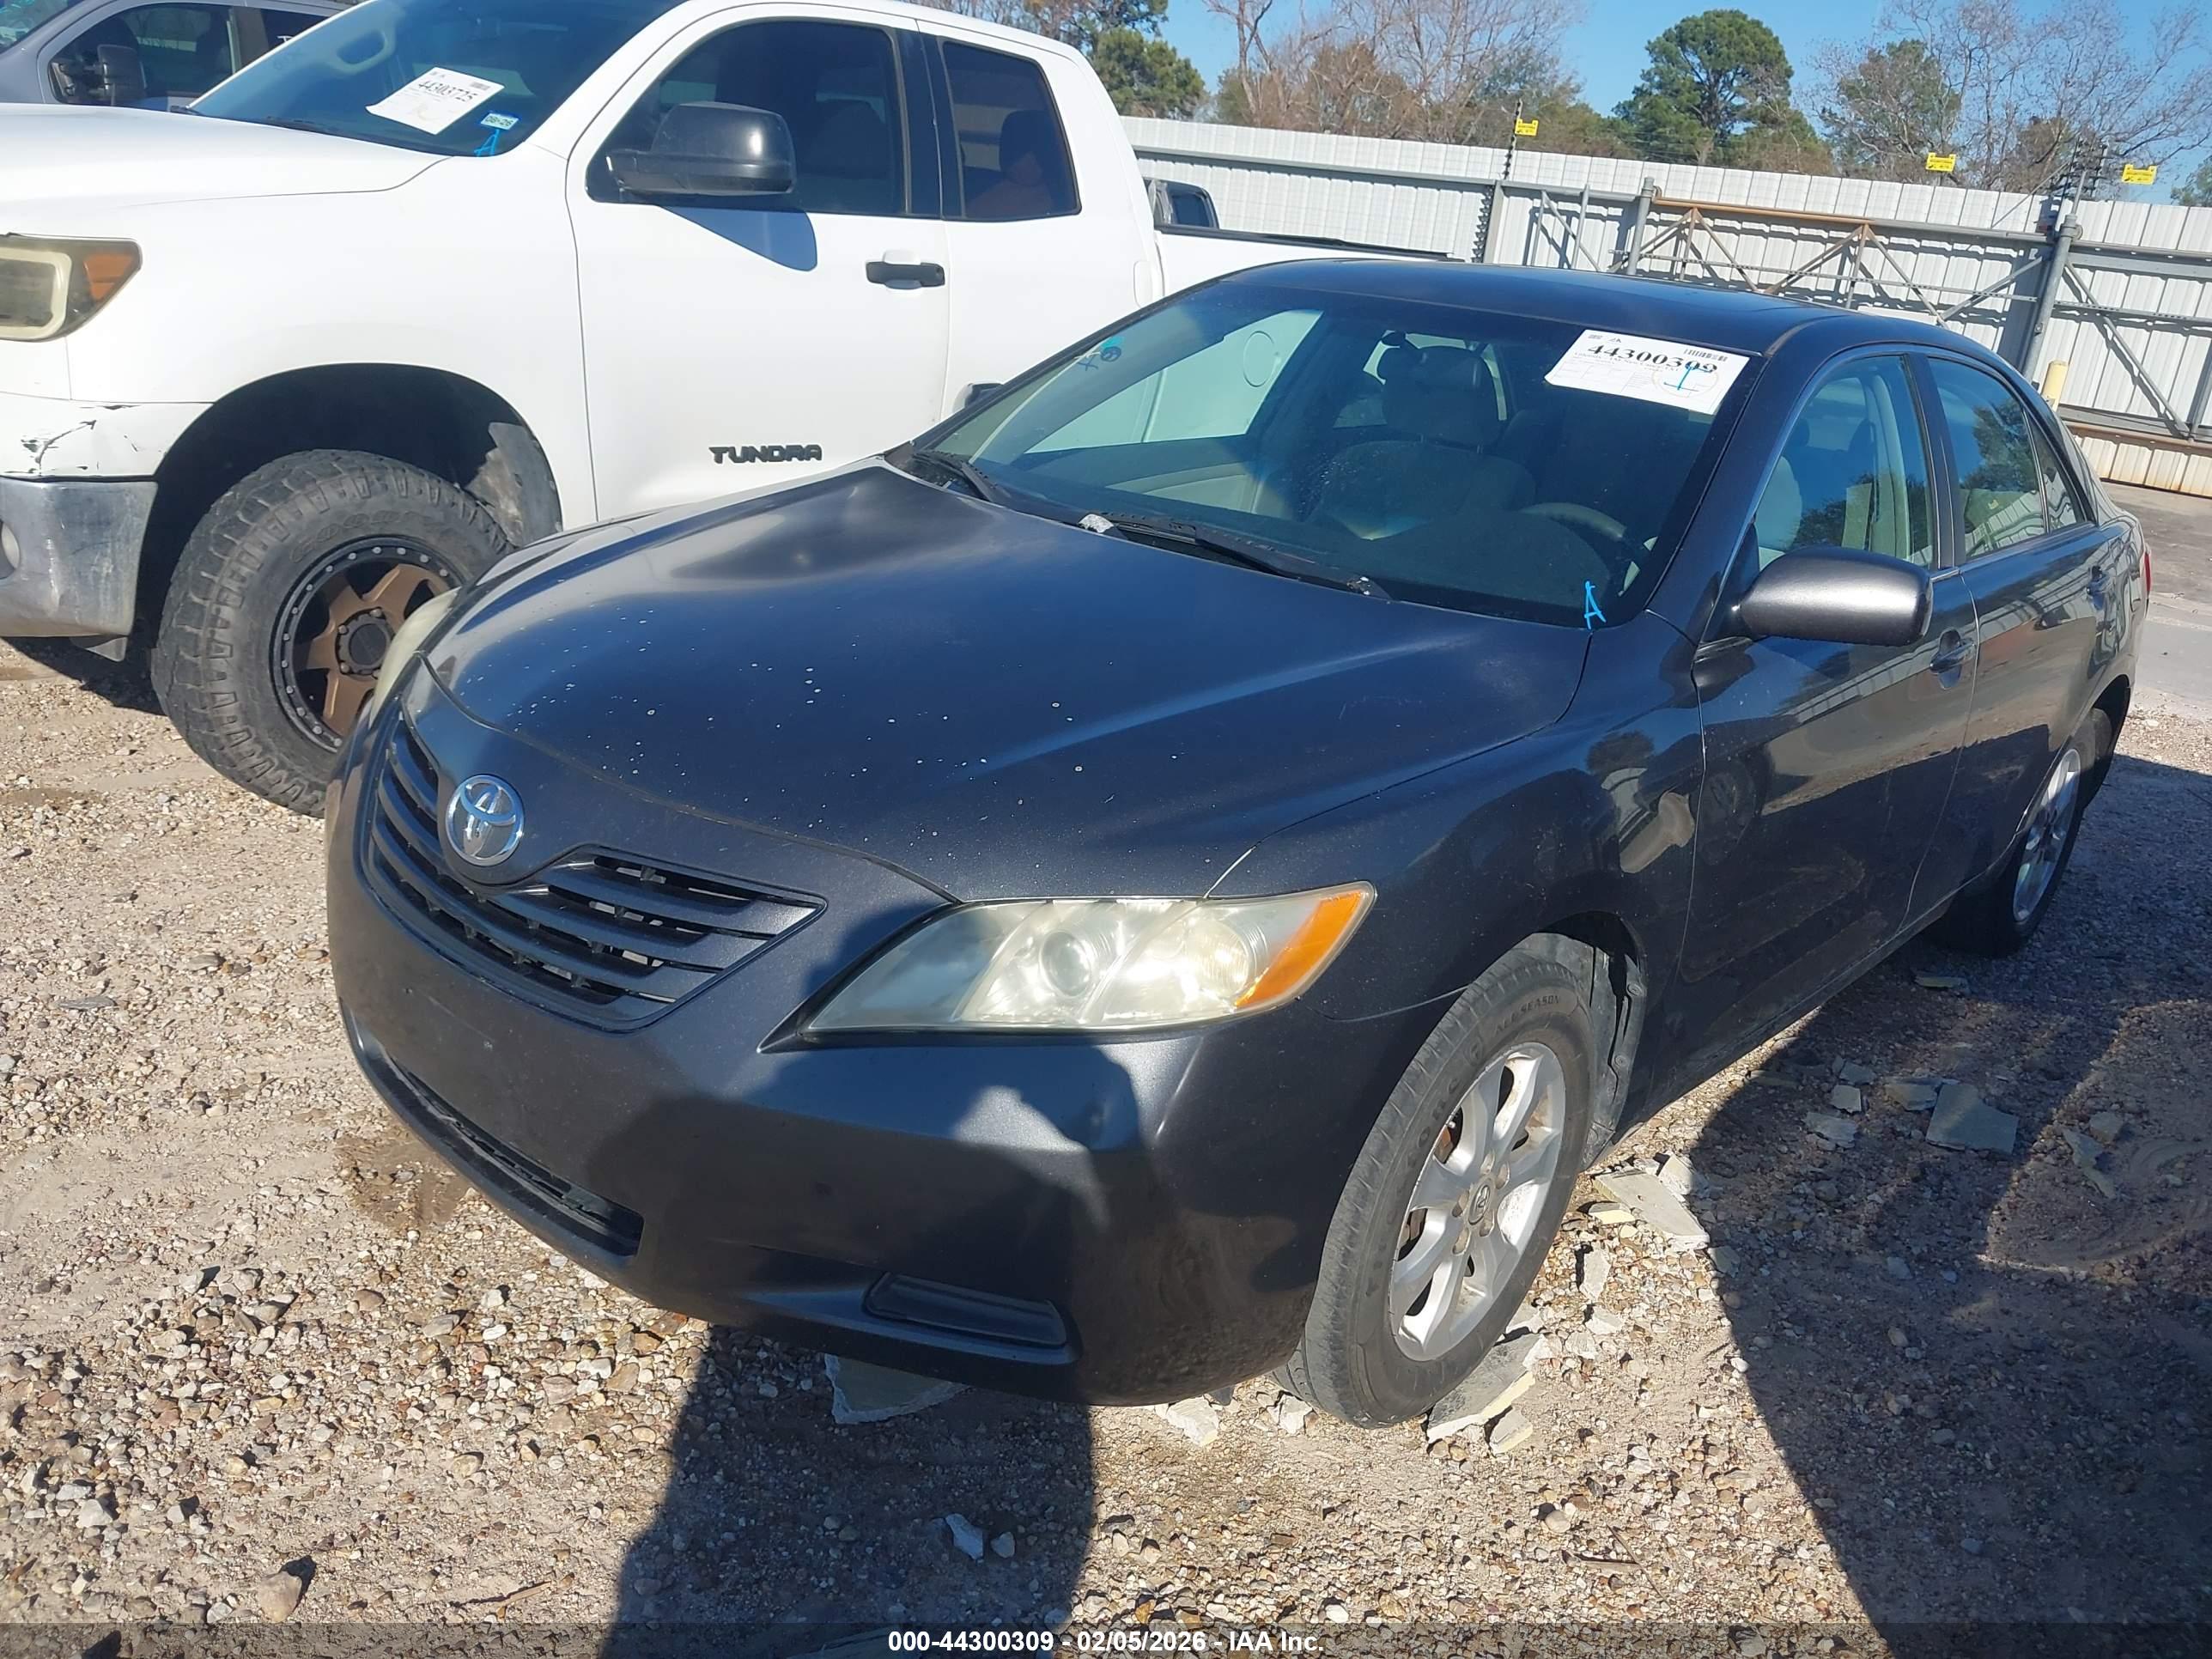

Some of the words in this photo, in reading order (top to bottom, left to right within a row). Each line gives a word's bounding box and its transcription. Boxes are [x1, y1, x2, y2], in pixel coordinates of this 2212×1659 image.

[1588, 344, 1717, 373] 44300309
[708, 444, 823, 465] TUNDRA
[1583, 580, 1607, 629] A
